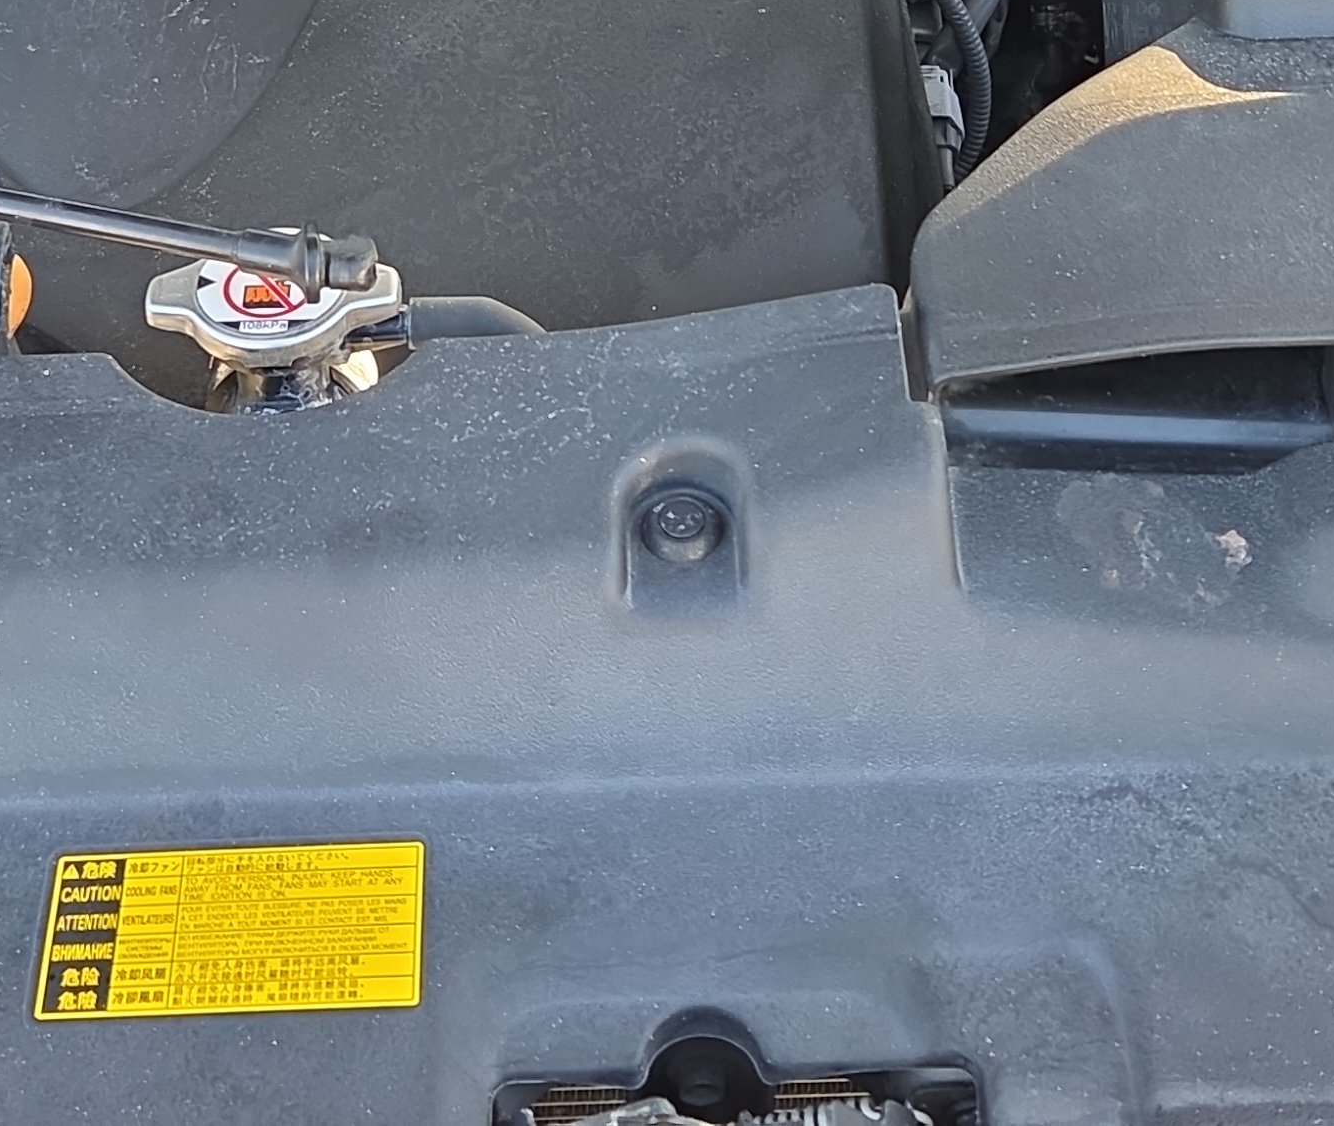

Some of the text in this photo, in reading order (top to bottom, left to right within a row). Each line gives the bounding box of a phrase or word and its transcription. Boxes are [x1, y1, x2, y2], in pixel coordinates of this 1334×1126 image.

[60, 884, 122, 903] CAUTION
[125, 885, 178, 898] COOLING FANS
[56, 913, 119, 932] ATTENTION
[122, 914, 175, 927] VENTILATEURS
[51, 942, 114, 962] ВНИМАНИЕ
